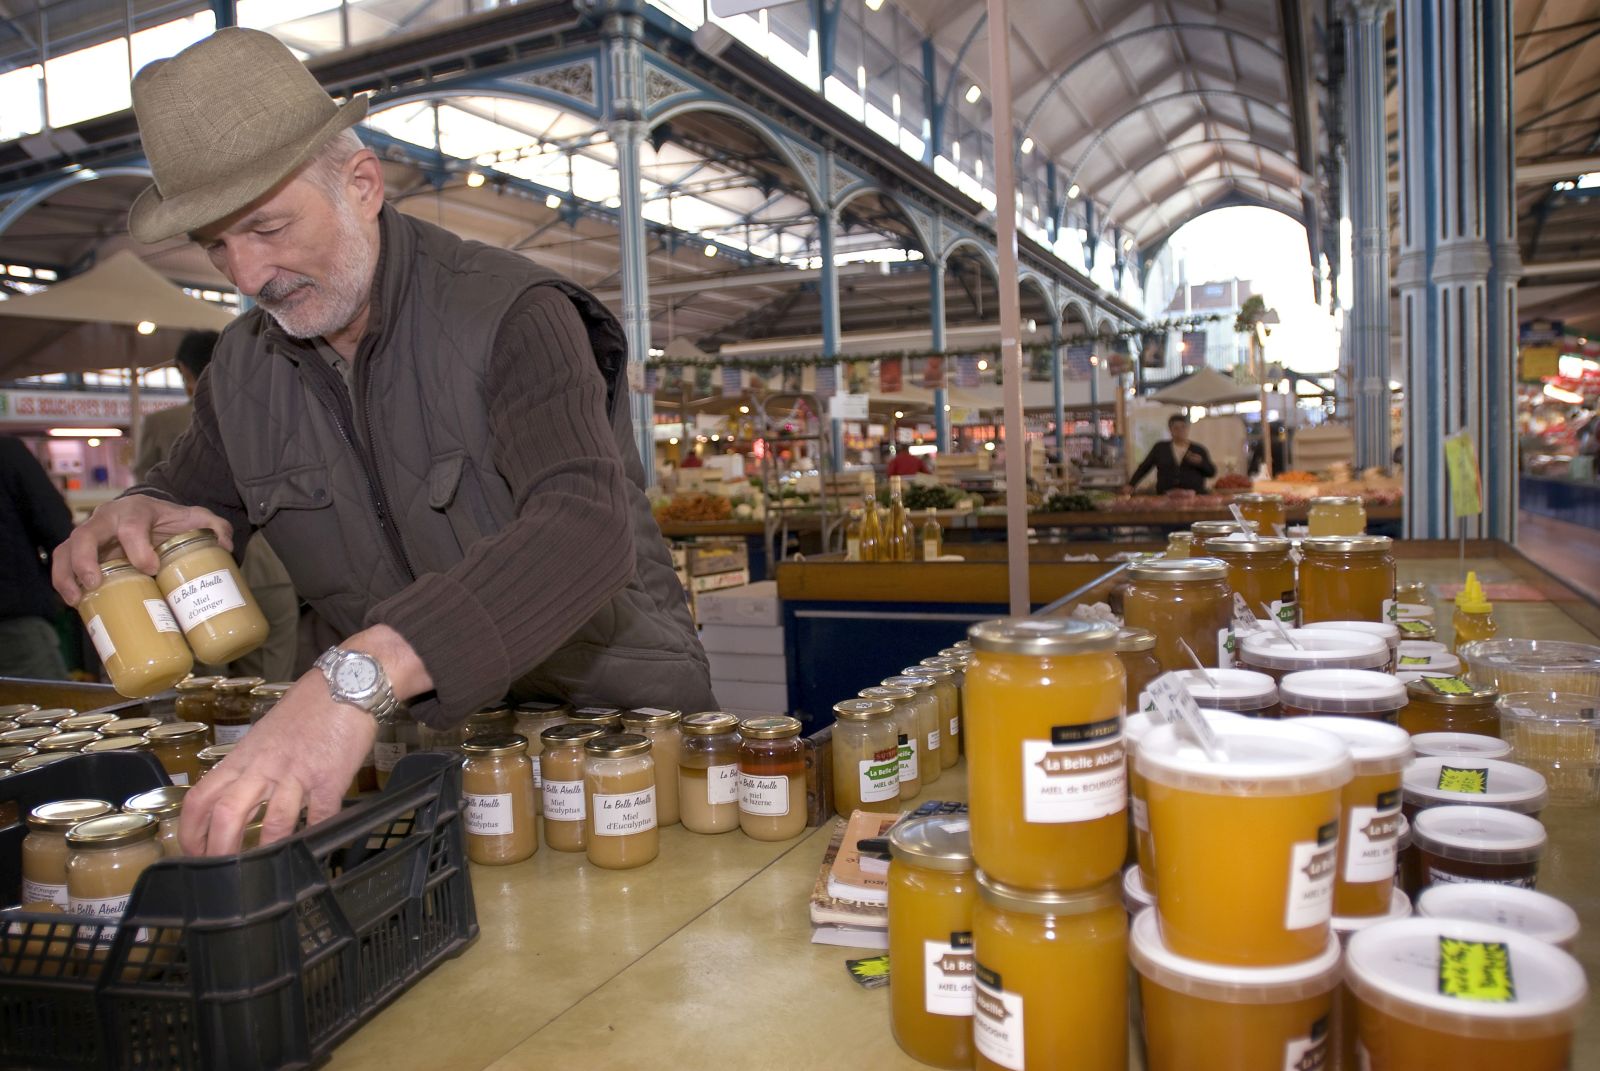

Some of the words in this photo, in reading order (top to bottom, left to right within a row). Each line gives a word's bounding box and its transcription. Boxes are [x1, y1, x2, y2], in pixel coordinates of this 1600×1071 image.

[173, 594, 182, 605] La
[181, 584, 199, 600] Belle
[200, 575, 224, 590] Abeille
[193, 594, 210, 608] Miel
[188, 597, 224, 620] d'Oranger
[1046, 759, 1061, 771] La
[1063, 756, 1093, 770] Belle
[720, 771, 728, 779] La
[879, 767, 891, 776] Belle
[546, 784, 558, 792] Belle
[560, 785, 581, 794] Abeille
[743, 778, 755, 789] Belle
[756, 781, 778, 790] Abeille
[873, 781, 887, 789] MIEL
[1040, 786, 1063, 795] MIEL
[749, 792, 762, 800] miel
[478, 798, 501, 808] Abeille
[603, 800, 612, 809] La
[614, 799, 632, 809] Belle
[470, 812, 483, 820] Miel
[622, 812, 639, 821] Miel
[606, 818, 652, 830] d'Eucalyptus
[77, 903, 96, 916] Belle
[98, 901, 128, 915] Abeill
[943, 960, 956, 971] La
[938, 983, 959, 992] MIEL
